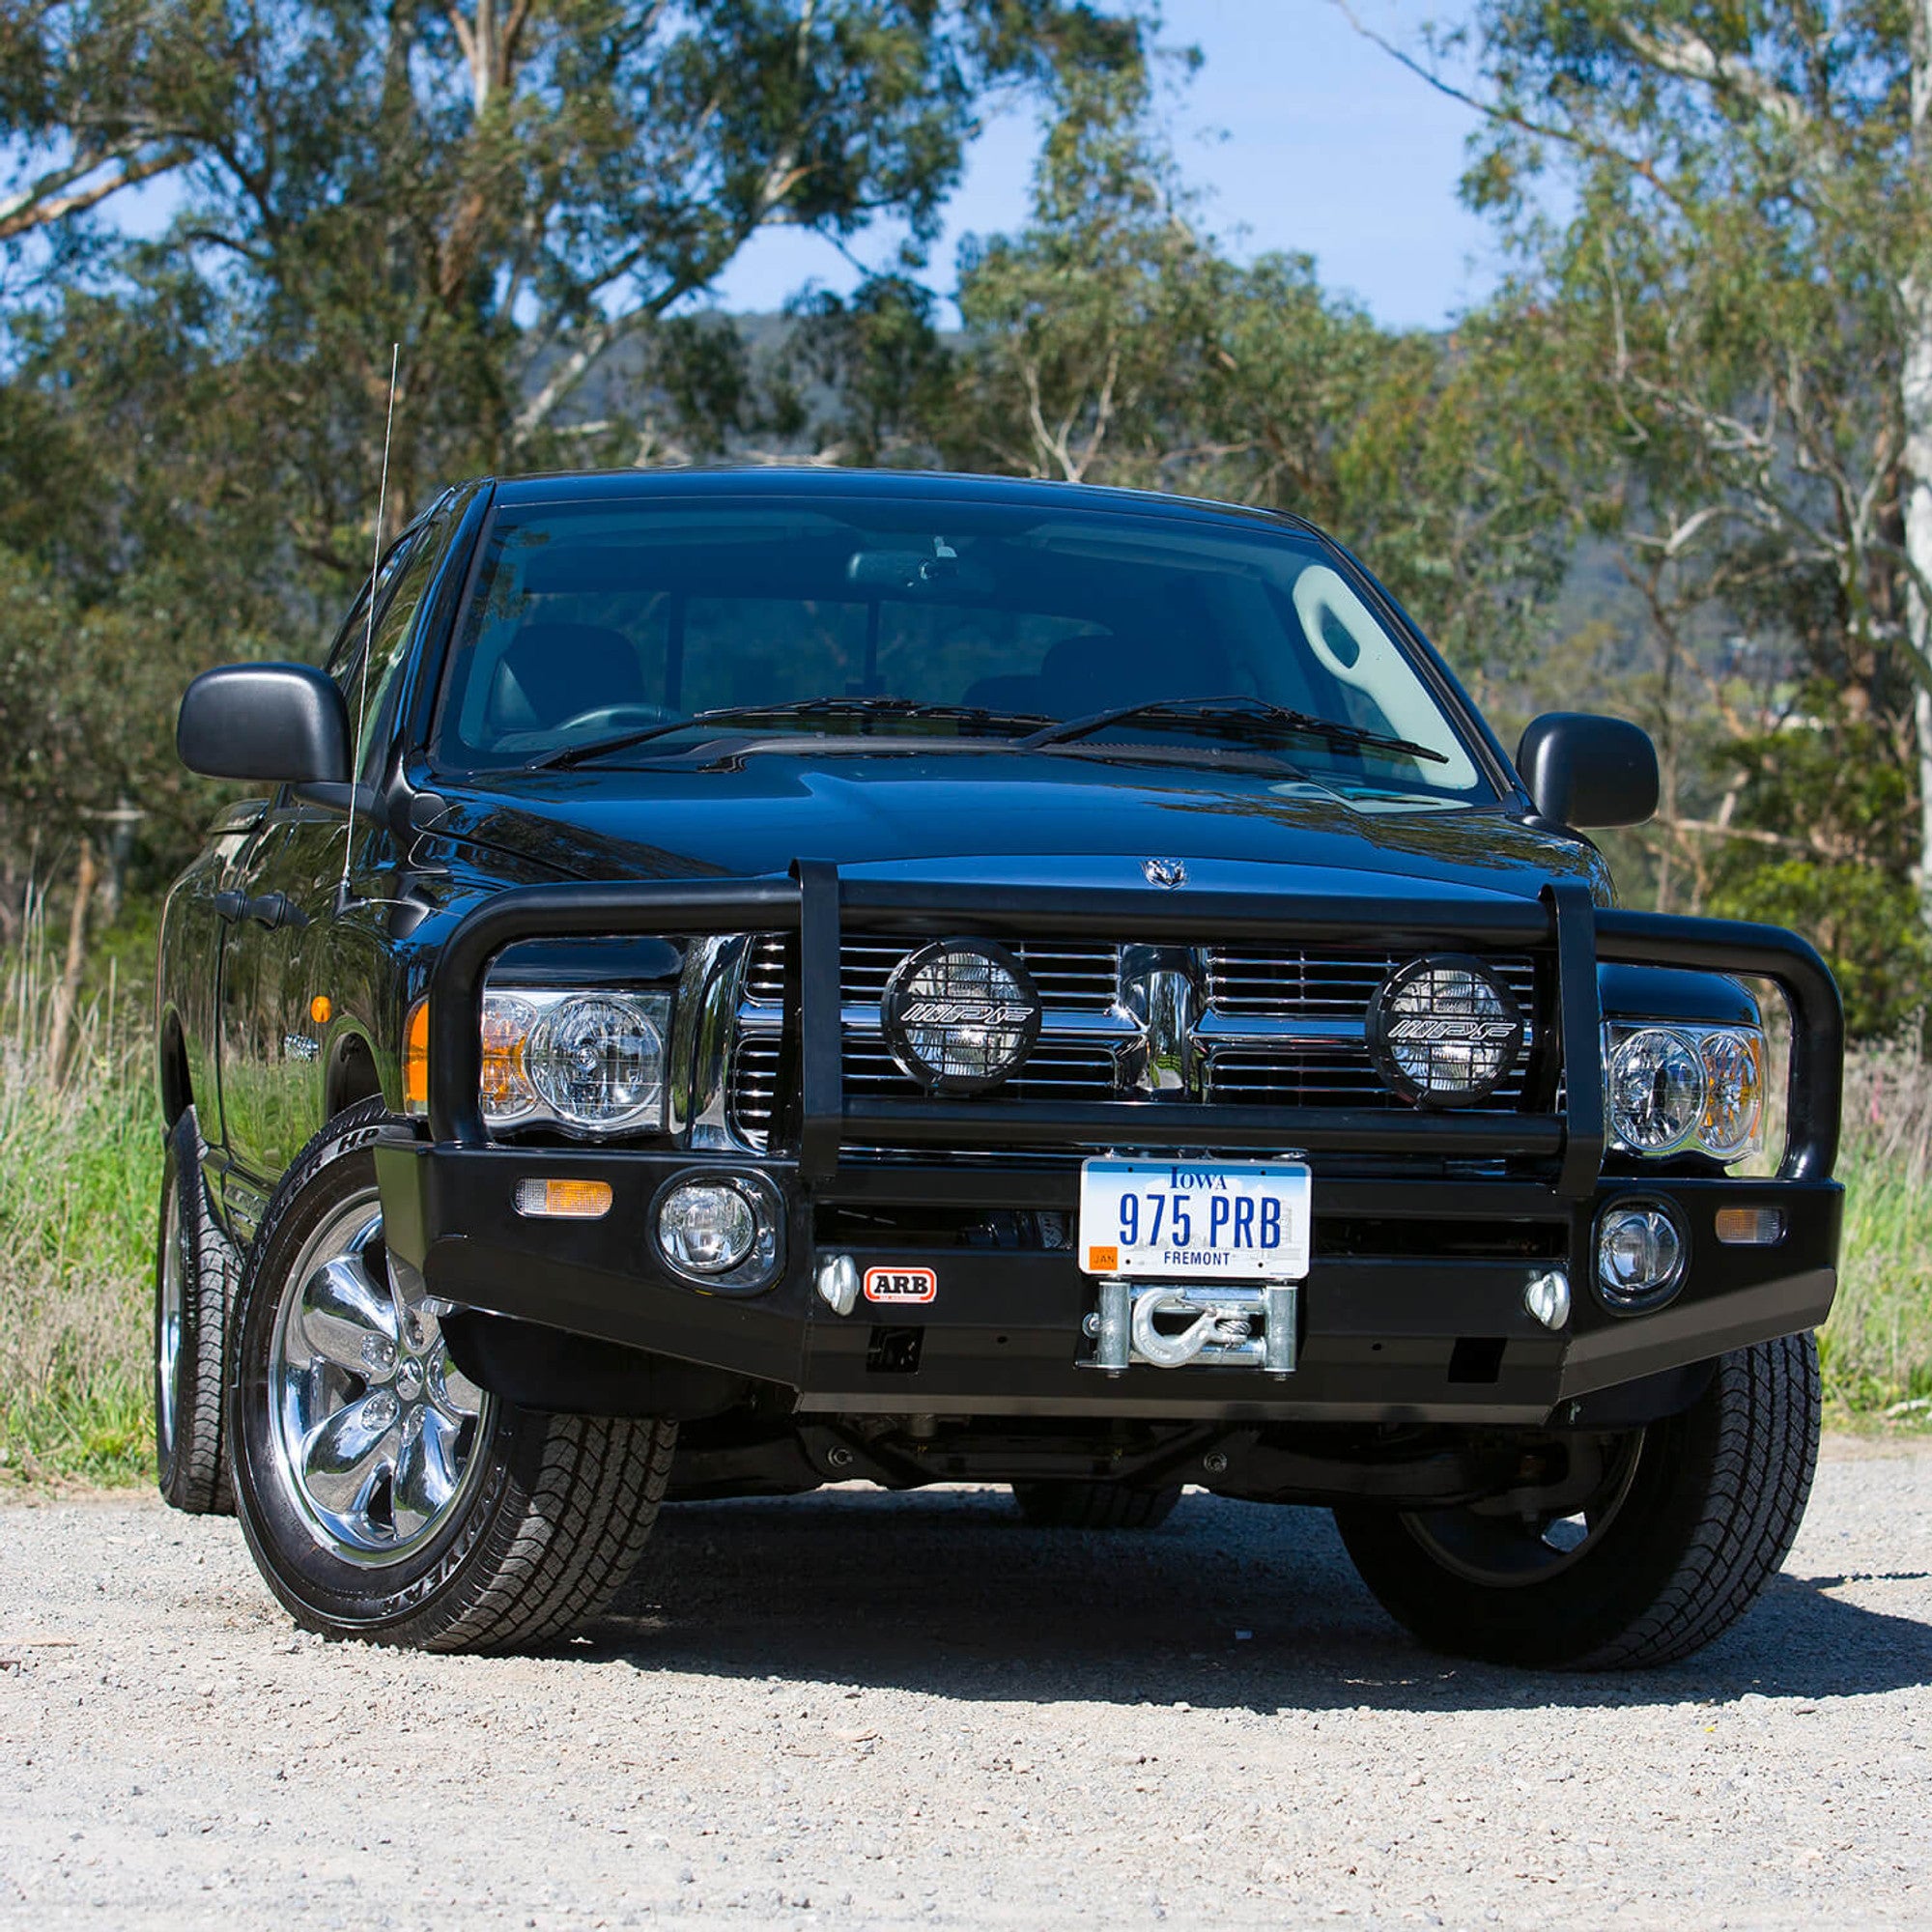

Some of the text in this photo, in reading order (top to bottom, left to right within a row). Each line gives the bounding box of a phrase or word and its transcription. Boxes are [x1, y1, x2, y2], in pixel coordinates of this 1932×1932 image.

[1119, 1193, 1281, 1249] 975 PRB
[1164, 1251, 1231, 1265] FREMONT
[873, 1275, 928, 1294] ARB
